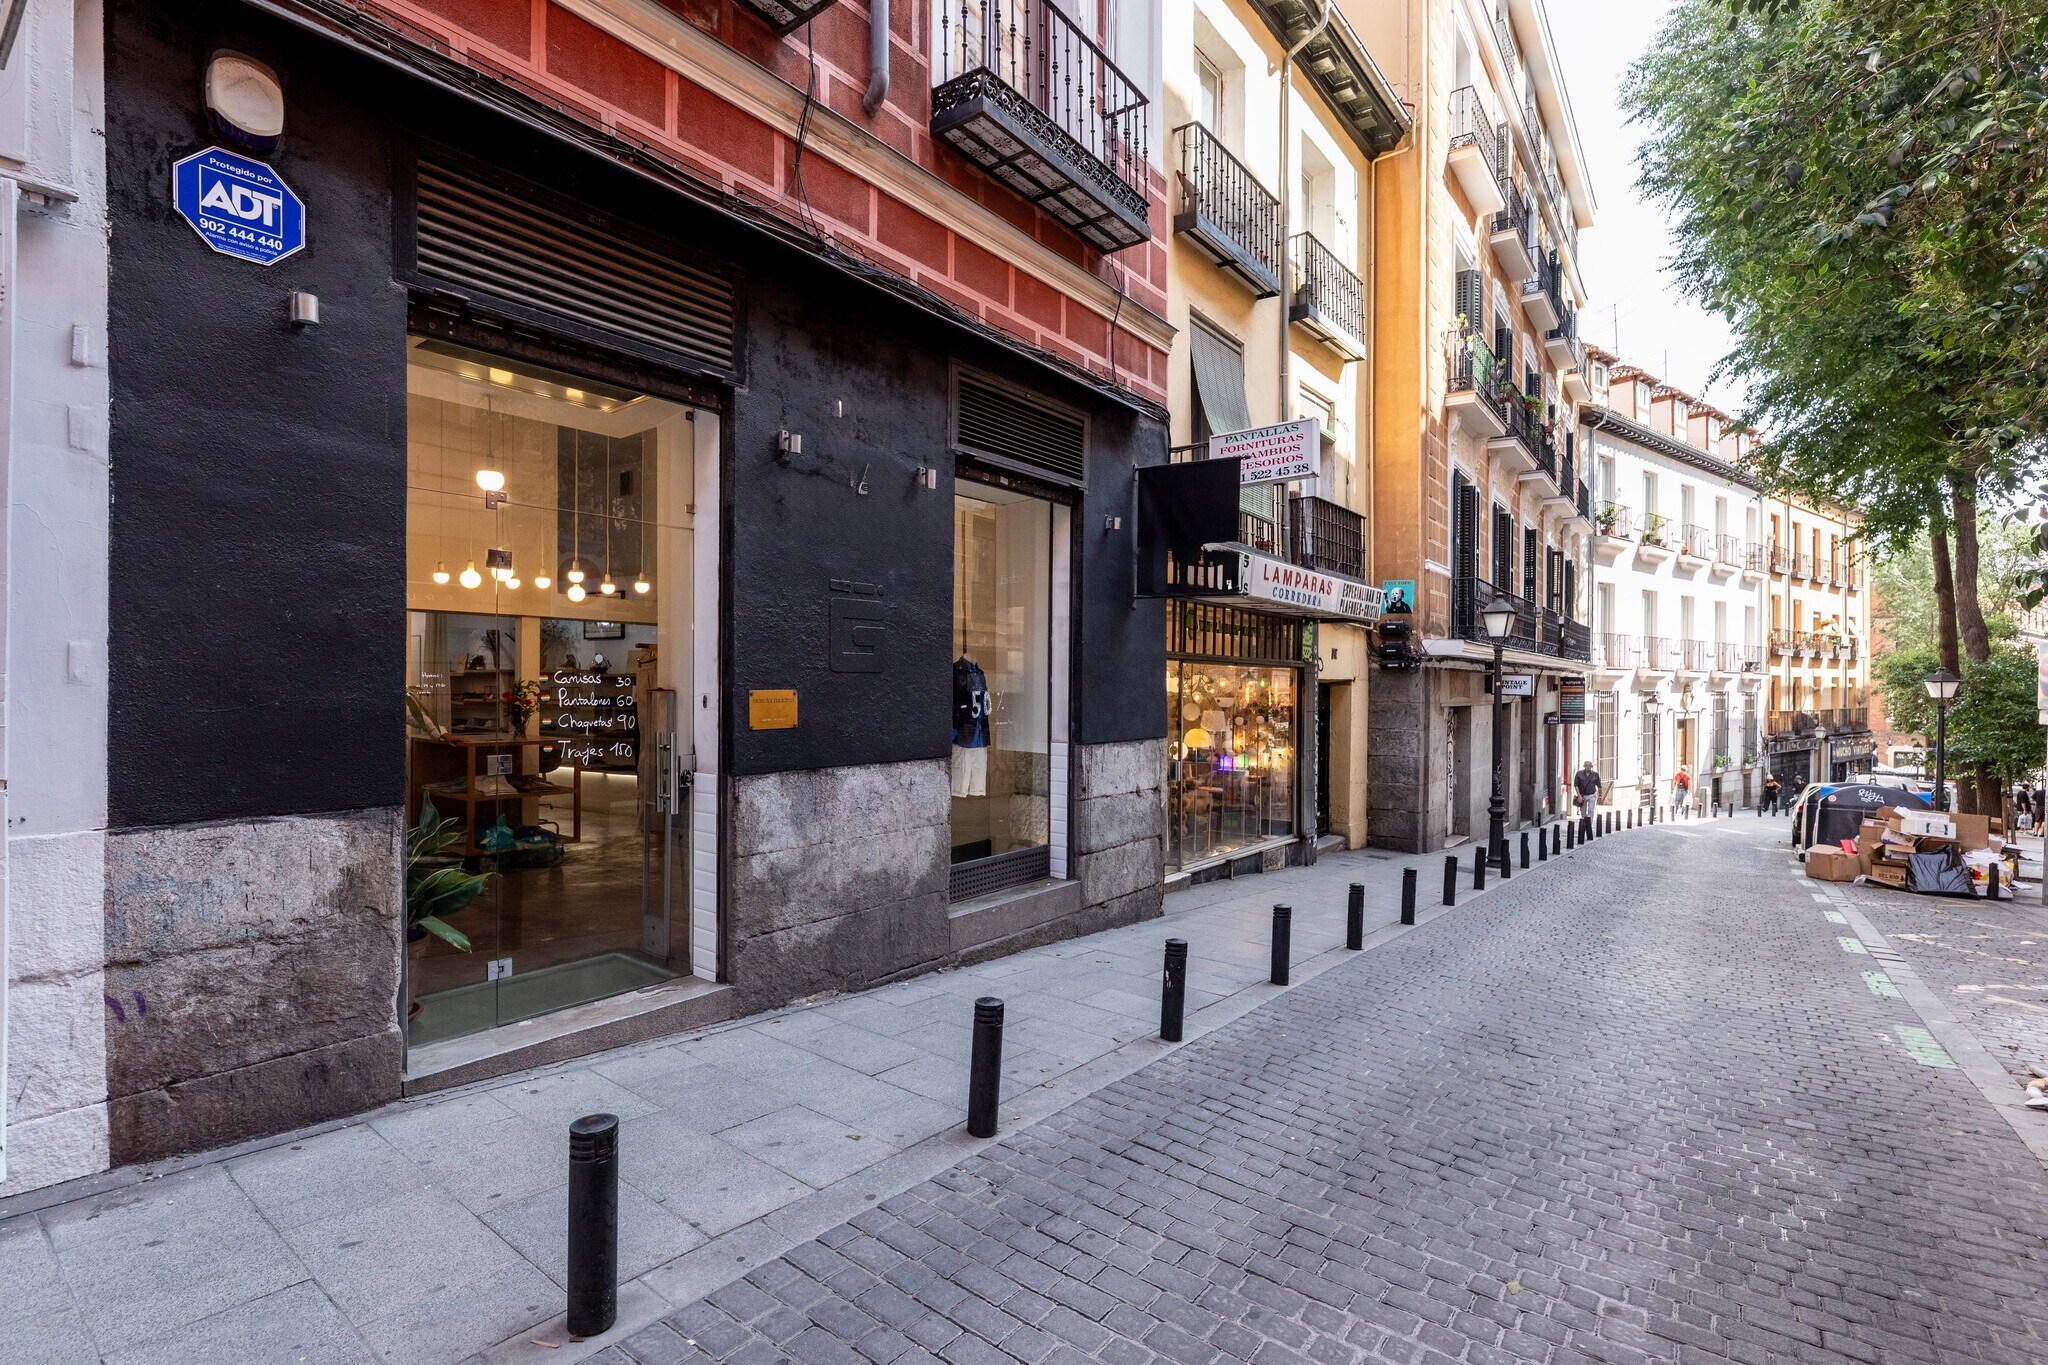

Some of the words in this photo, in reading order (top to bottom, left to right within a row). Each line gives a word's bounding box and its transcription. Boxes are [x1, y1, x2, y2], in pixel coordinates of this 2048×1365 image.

[209, 157, 255, 179] Protegido
[257, 174, 273, 184] por
[201, 180, 282, 227] ADT
[200, 218, 226, 235] 902
[229, 227, 255, 243] 444
[258, 235, 283, 251] 440
[1220, 433, 1304, 455] FORNITURAS
[1225, 423, 1300, 444] PANTALLAS
[1250, 469, 1272, 481] 522
[1275, 466, 1290, 476] 45
[1293, 463, 1309, 473] 38
[1263, 563, 1333, 596] LAMPARAS
[1272, 586, 1322, 607] CORREDERA
[1342, 583, 1375, 604] ESPECIALIDAD
[554, 670, 602, 684] Camisas
[615, 677, 631, 687] 30
[558, 687, 611, 707] Pantalones
[616, 694, 634, 707] 60
[557, 713, 613, 735] Chaquetas
[617, 714, 636, 730] 90
[557, 740, 604, 766] Trajes
[609, 742, 633, 758] 150
